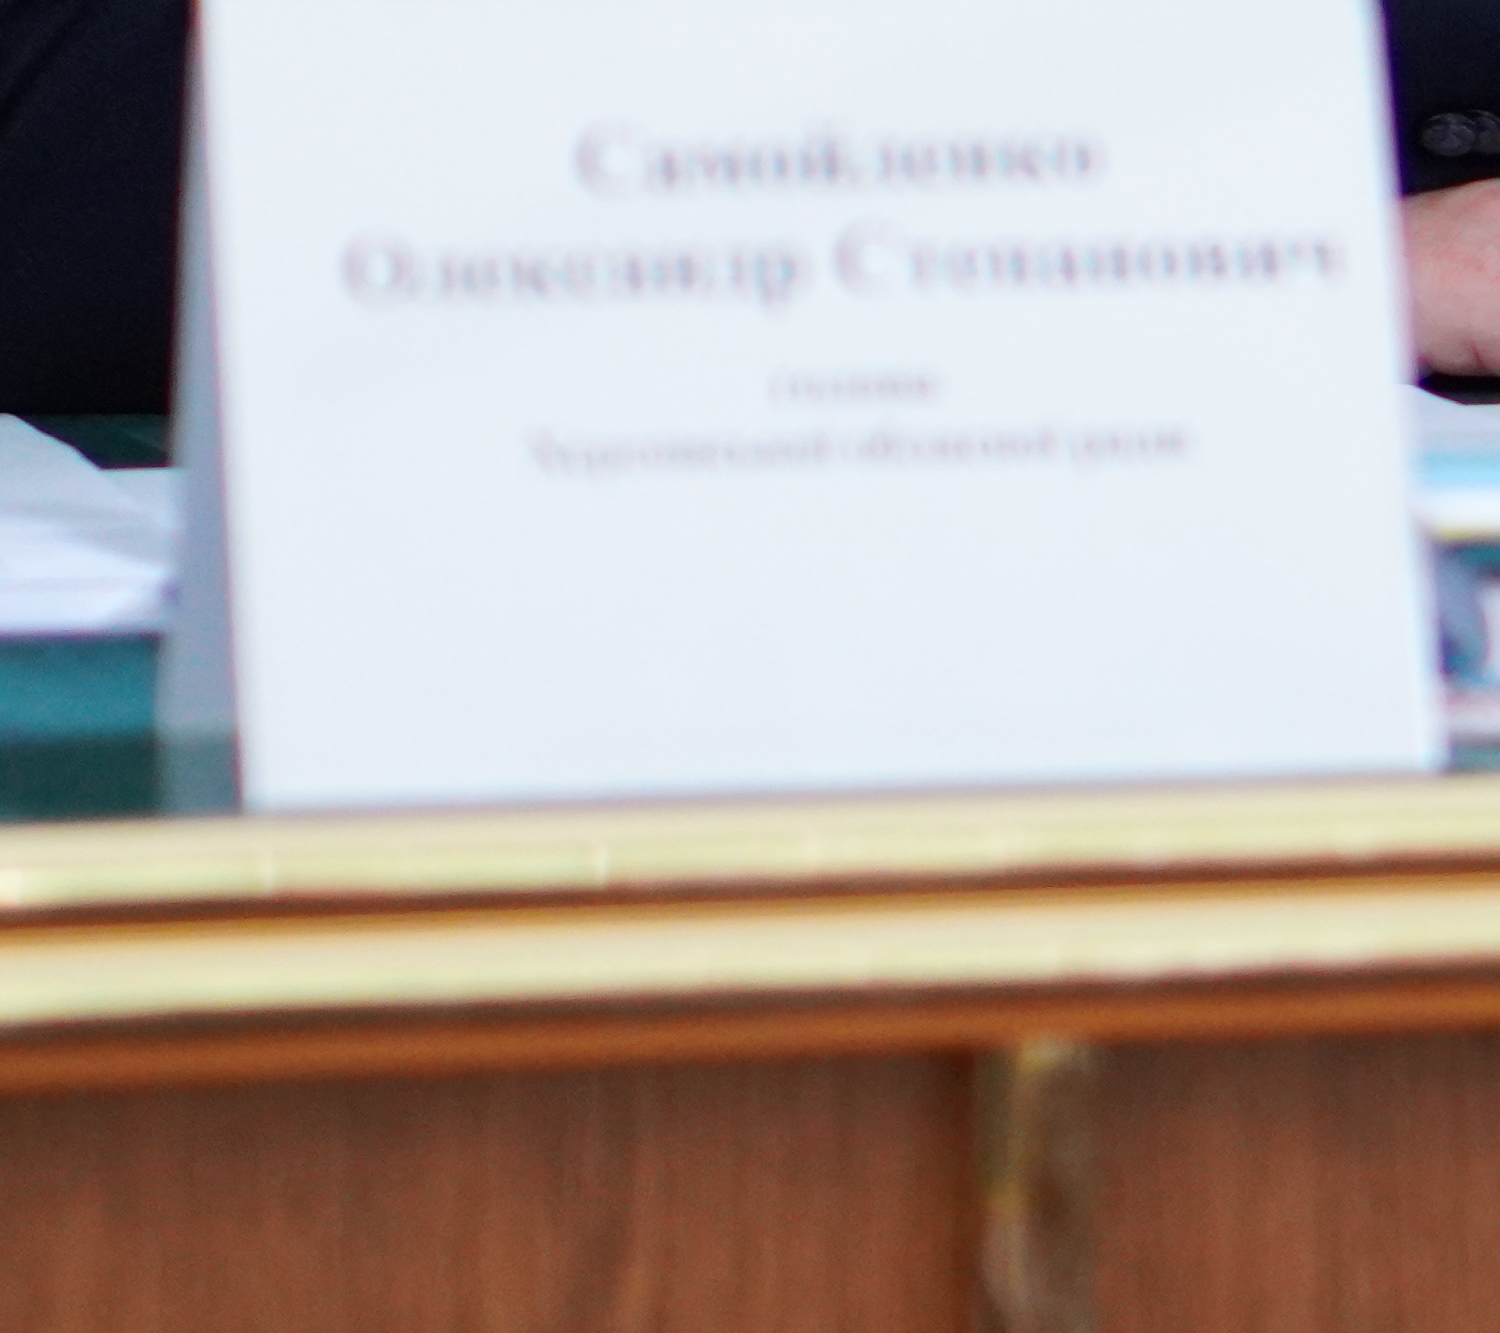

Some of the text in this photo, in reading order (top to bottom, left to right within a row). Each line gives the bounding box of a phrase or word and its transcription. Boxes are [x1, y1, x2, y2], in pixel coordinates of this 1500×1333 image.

[573, 121, 1105, 197] Самойленко
[343, 223, 1342, 310] Олександр Степанович
